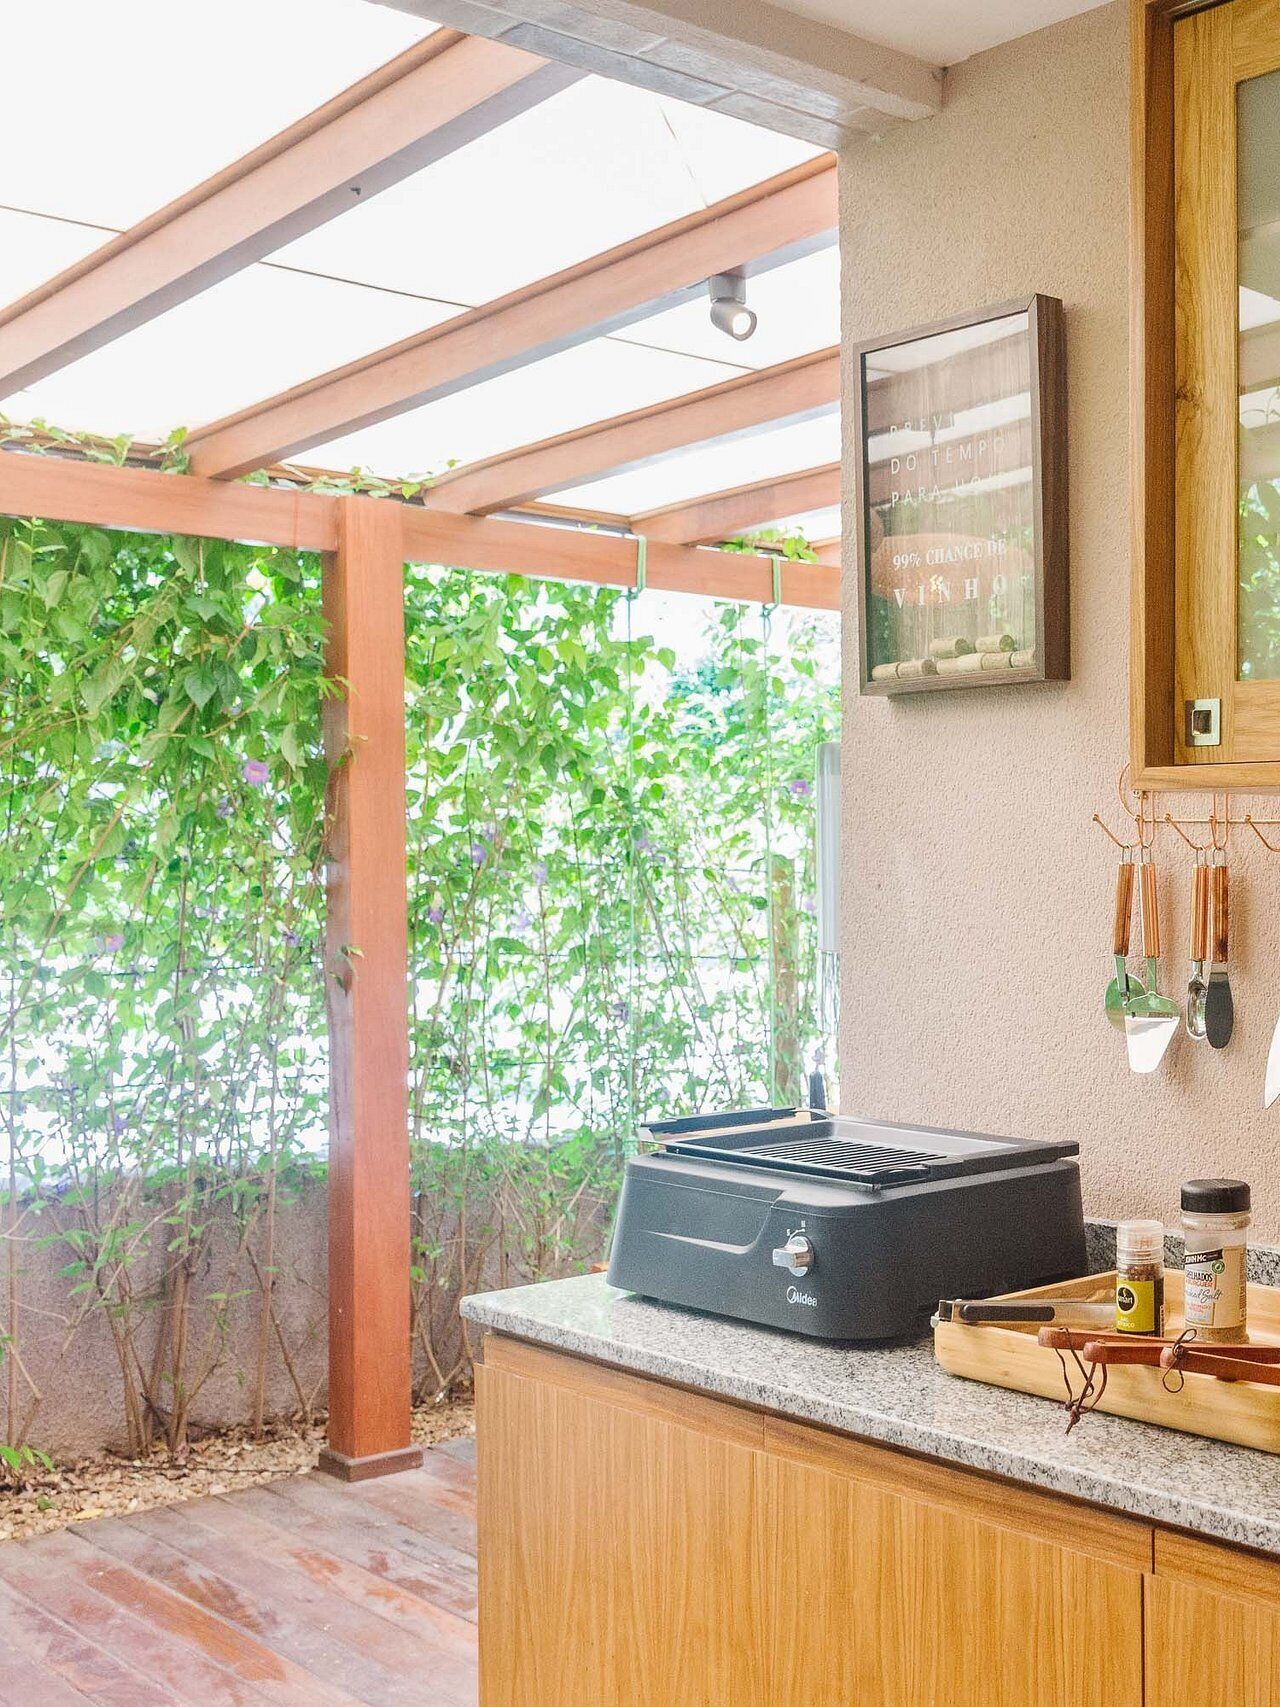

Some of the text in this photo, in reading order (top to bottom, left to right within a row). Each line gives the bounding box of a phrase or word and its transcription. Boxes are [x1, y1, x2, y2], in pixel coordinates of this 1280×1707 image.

[891, 437, 1006, 475] DO TEMPO
[891, 484, 941, 508] PARA
[892, 552, 920, 570] 99%
[892, 574, 1008, 609] VINHO
[786, 1285, 818, 1307] Midea
